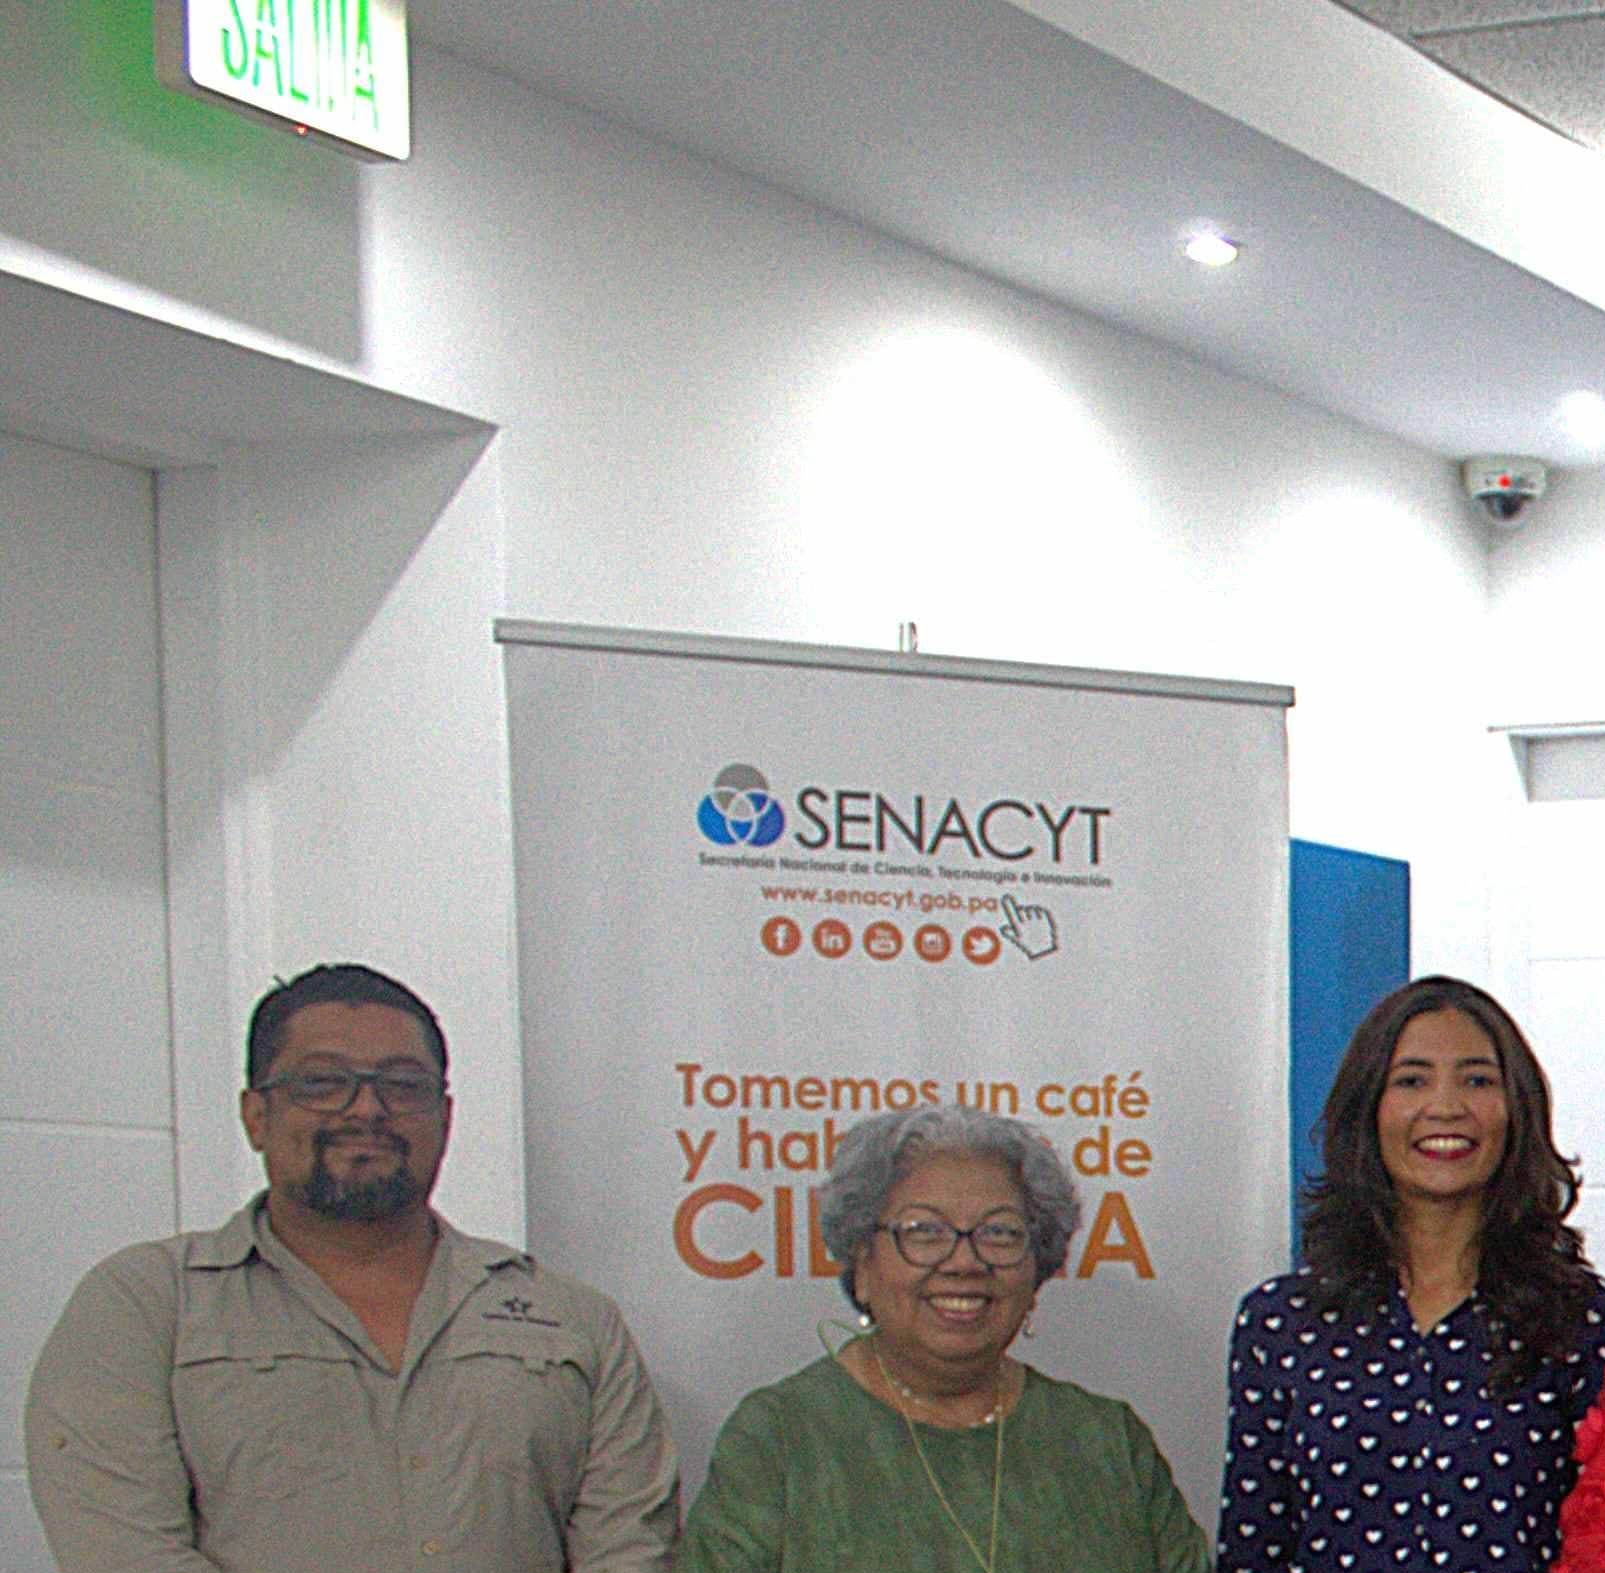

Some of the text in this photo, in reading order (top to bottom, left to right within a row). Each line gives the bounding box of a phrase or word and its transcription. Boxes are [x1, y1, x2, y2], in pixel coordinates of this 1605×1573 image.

[795, 786, 1111, 864] SENACYT
[779, 857, 847, 872] Nacional
[850, 862, 869, 874] de
[761, 886, 999, 915] www.senacyt.gob.pa
[675, 1063, 1151, 1119] Tomemos un café
[675, 1129, 717, 1182] y
[1072, 1126, 1152, 1178] de
